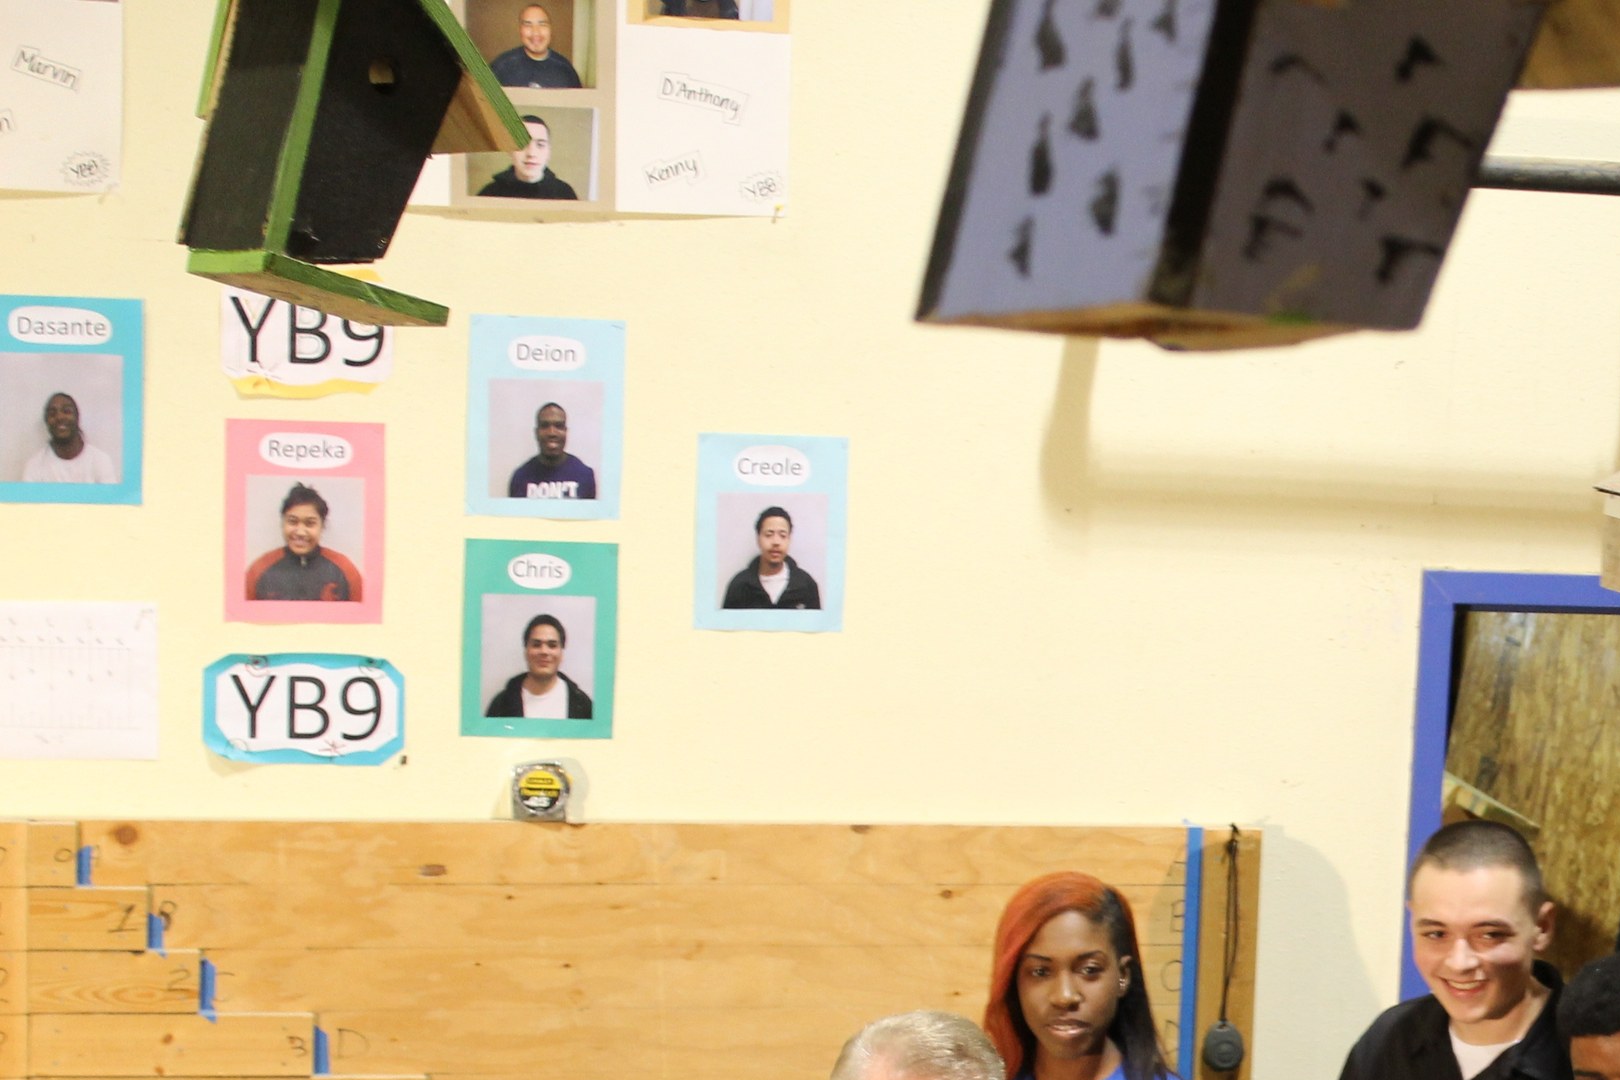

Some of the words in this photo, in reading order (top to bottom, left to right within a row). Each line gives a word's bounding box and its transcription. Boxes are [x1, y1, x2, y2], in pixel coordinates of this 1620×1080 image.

[14, 50, 77, 88] Marvin
[645, 159, 698, 186] Kenny
[17, 315, 108, 337] Dasante
[229, 296, 386, 367] YB9
[516, 343, 577, 363] Deion
[268, 439, 346, 462] Repeka
[737, 456, 803, 477] Creole
[512, 558, 564, 579] Chris
[231, 674, 382, 741] YB9
